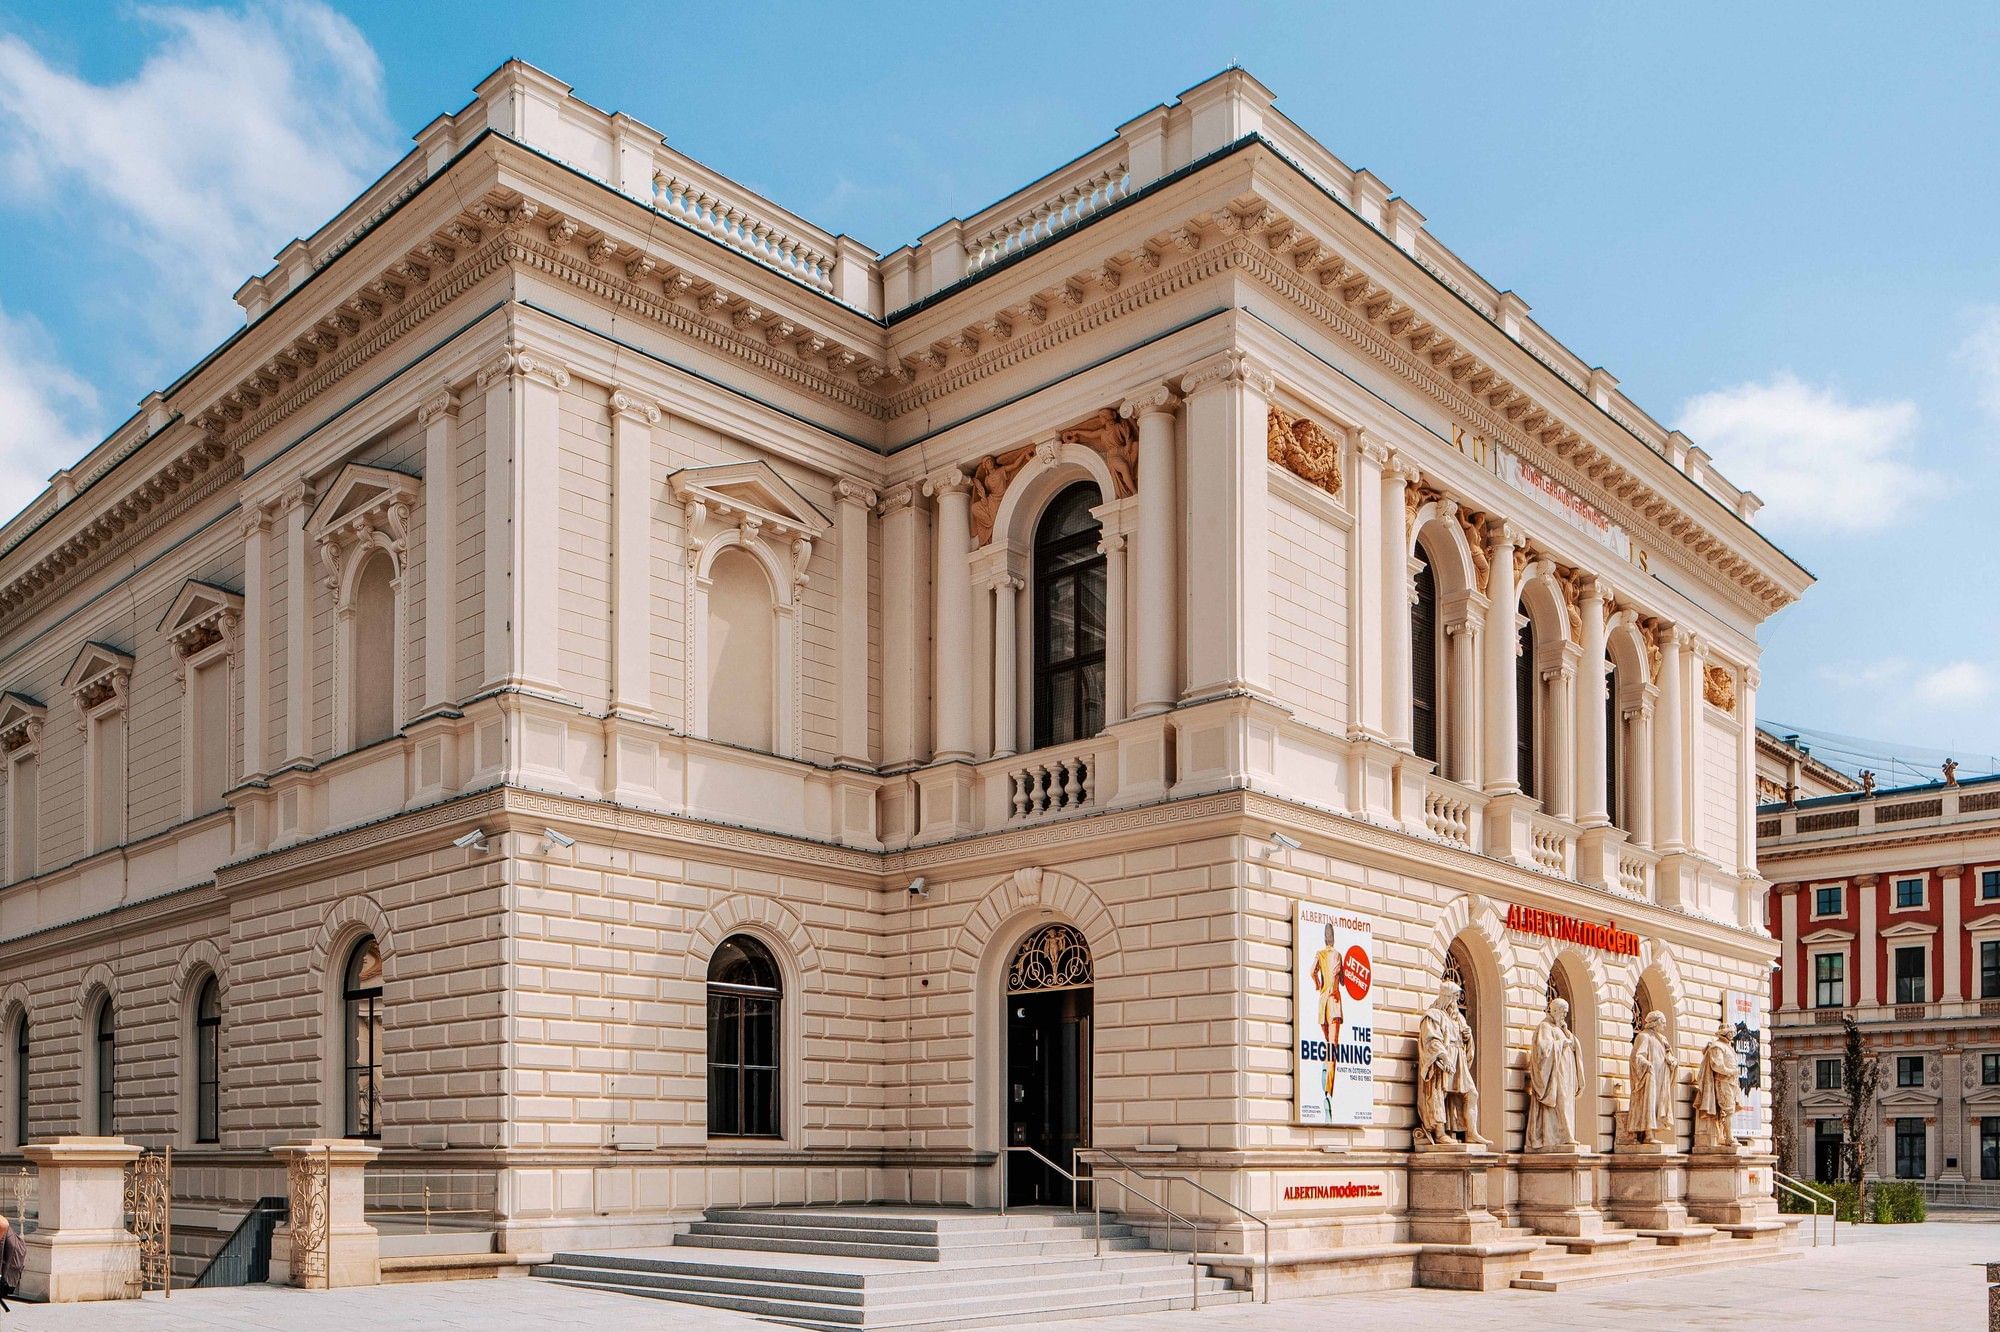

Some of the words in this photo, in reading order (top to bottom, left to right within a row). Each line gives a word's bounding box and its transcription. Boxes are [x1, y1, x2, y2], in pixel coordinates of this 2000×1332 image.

[1346, 955, 1370, 980] JETZT
[1352, 1026, 1371, 1042] THE
[1301, 1040, 1372, 1066] BEGINNING
